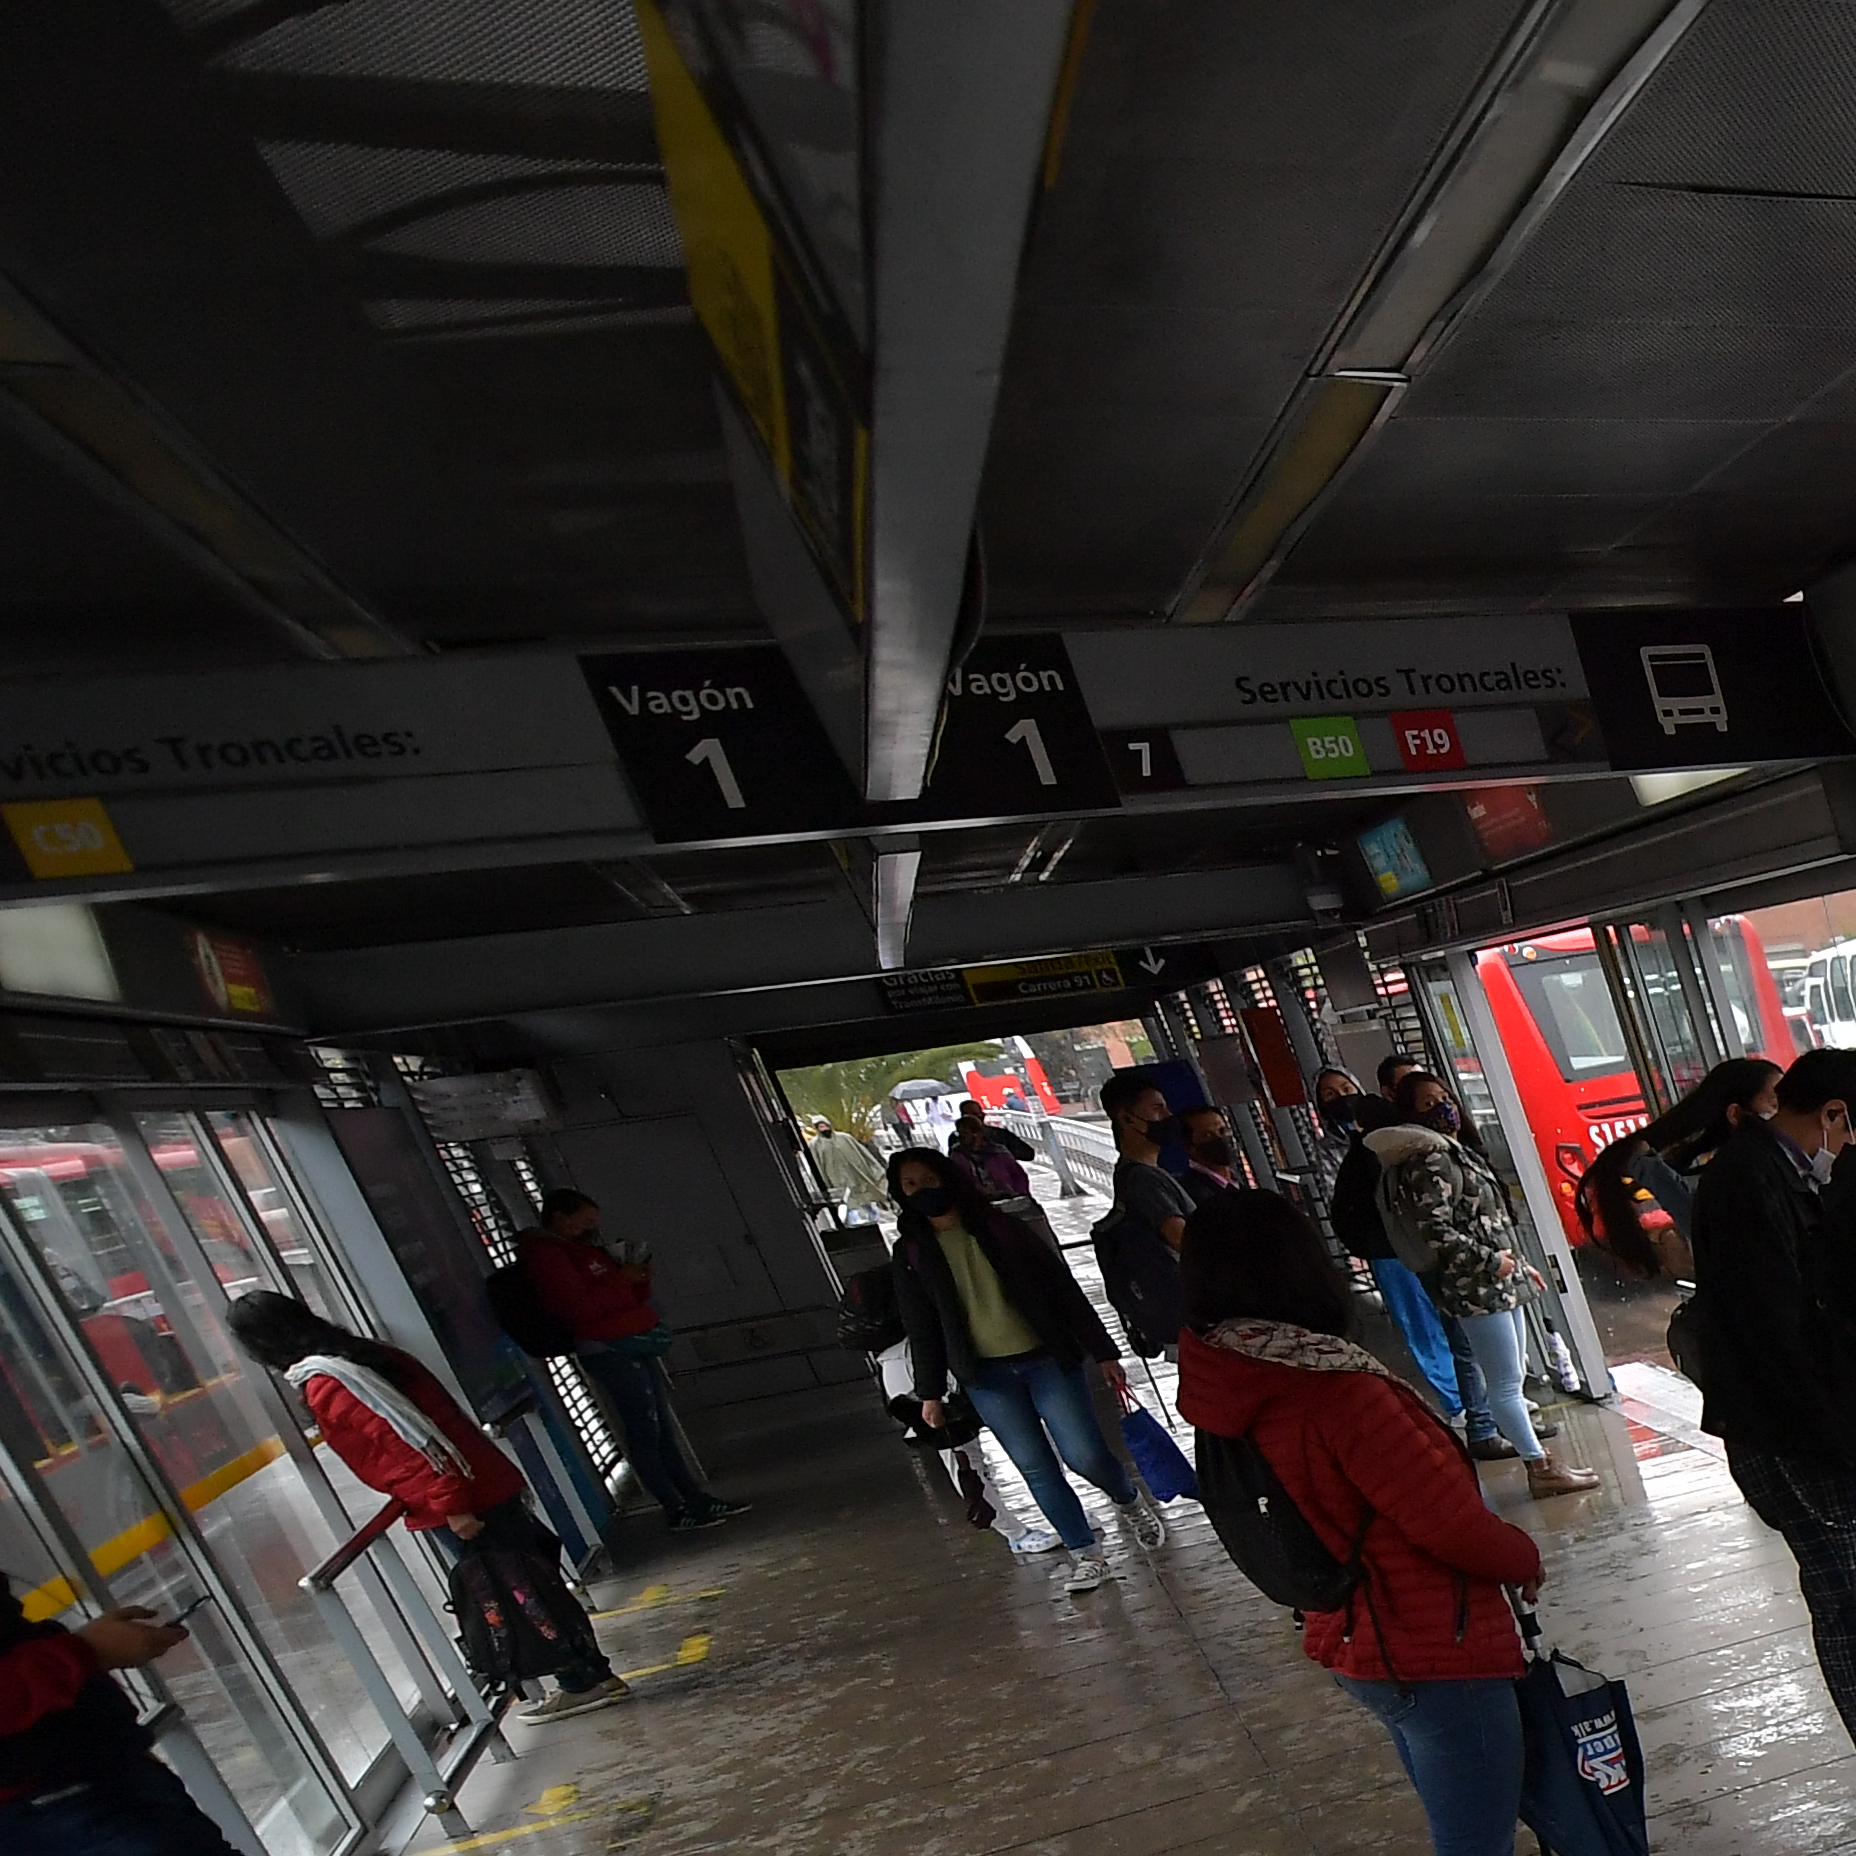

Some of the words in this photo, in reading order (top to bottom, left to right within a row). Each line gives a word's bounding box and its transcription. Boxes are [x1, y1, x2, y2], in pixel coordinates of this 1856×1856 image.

[609, 679, 754, 722] Vagón
[1235, 669, 1390, 705] Servicios
[1396, 663, 1565, 697] Troncales:
[154, 721, 420, 769] Troncales:
[1004, 718, 1057, 785] 1
[1128, 743, 1150, 777] 7
[1306, 733, 1354, 762] B50
[1405, 726, 1450, 757] F19
[685, 738, 745, 809] 1
[31, 821, 104, 853] C50
[1018, 974, 1070, 994] Carrera
[1073, 974, 1091, 989] 91
